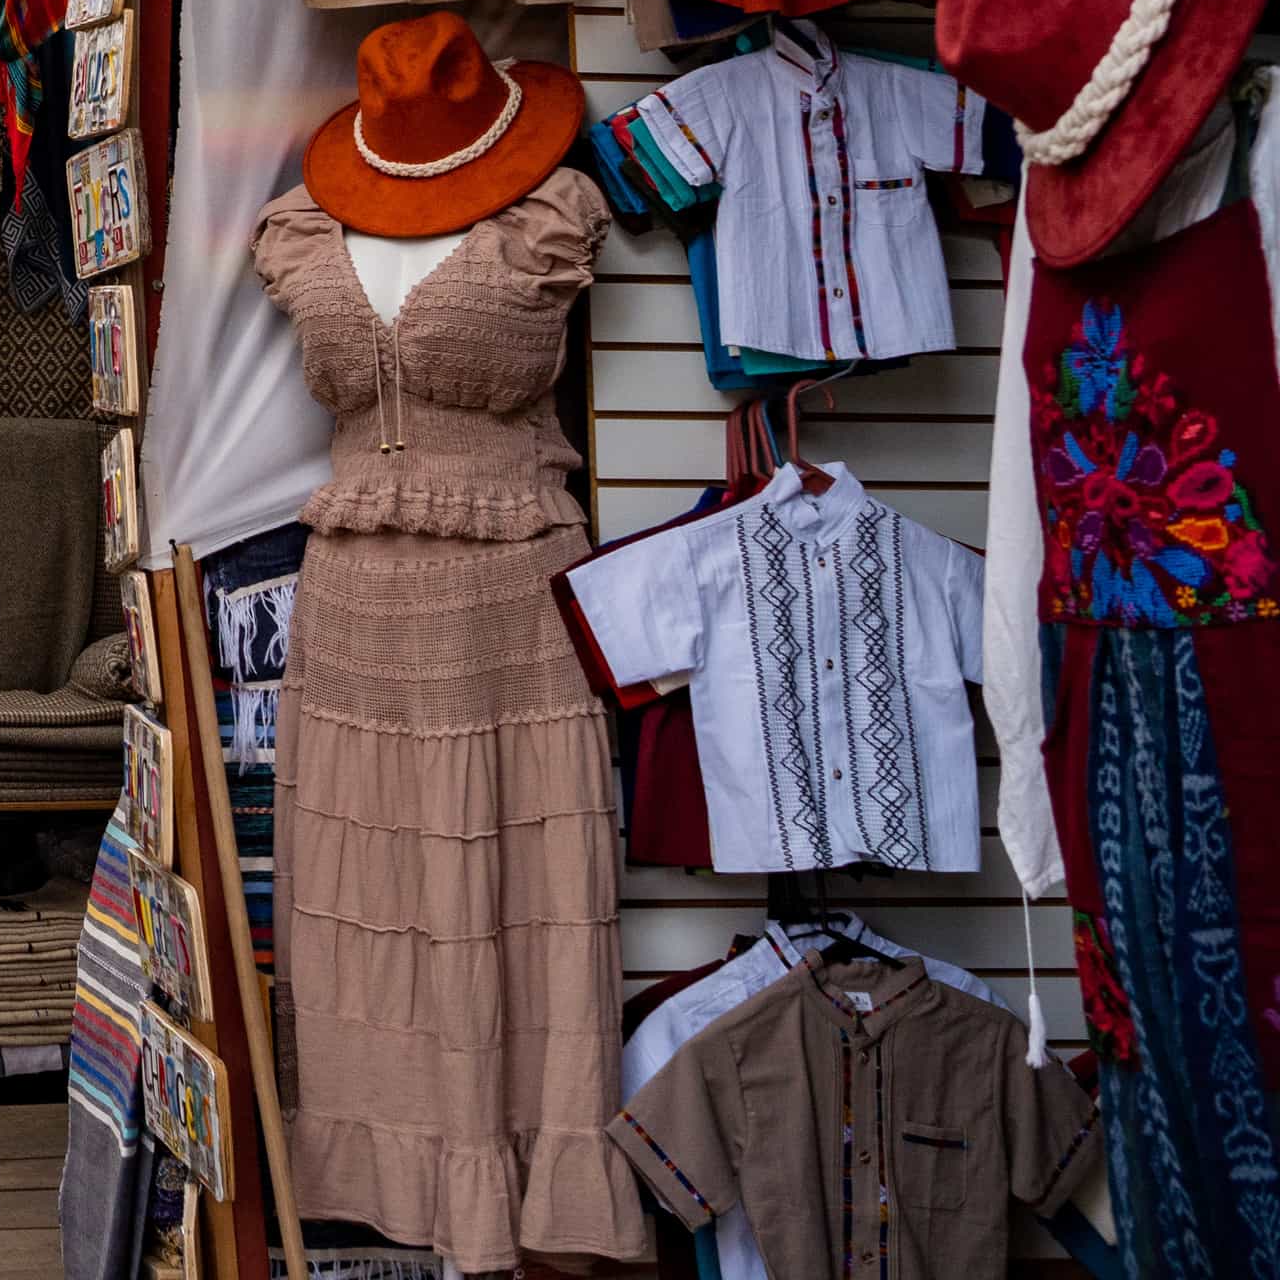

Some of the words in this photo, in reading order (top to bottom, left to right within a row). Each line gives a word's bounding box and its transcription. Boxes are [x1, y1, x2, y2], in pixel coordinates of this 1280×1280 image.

[74, 46, 118, 107] EAGLES
[74, 167, 131, 241] FLYERS
[133, 886, 190, 976] NUGGETS
[142, 1037, 213, 1147] CHARGERS
